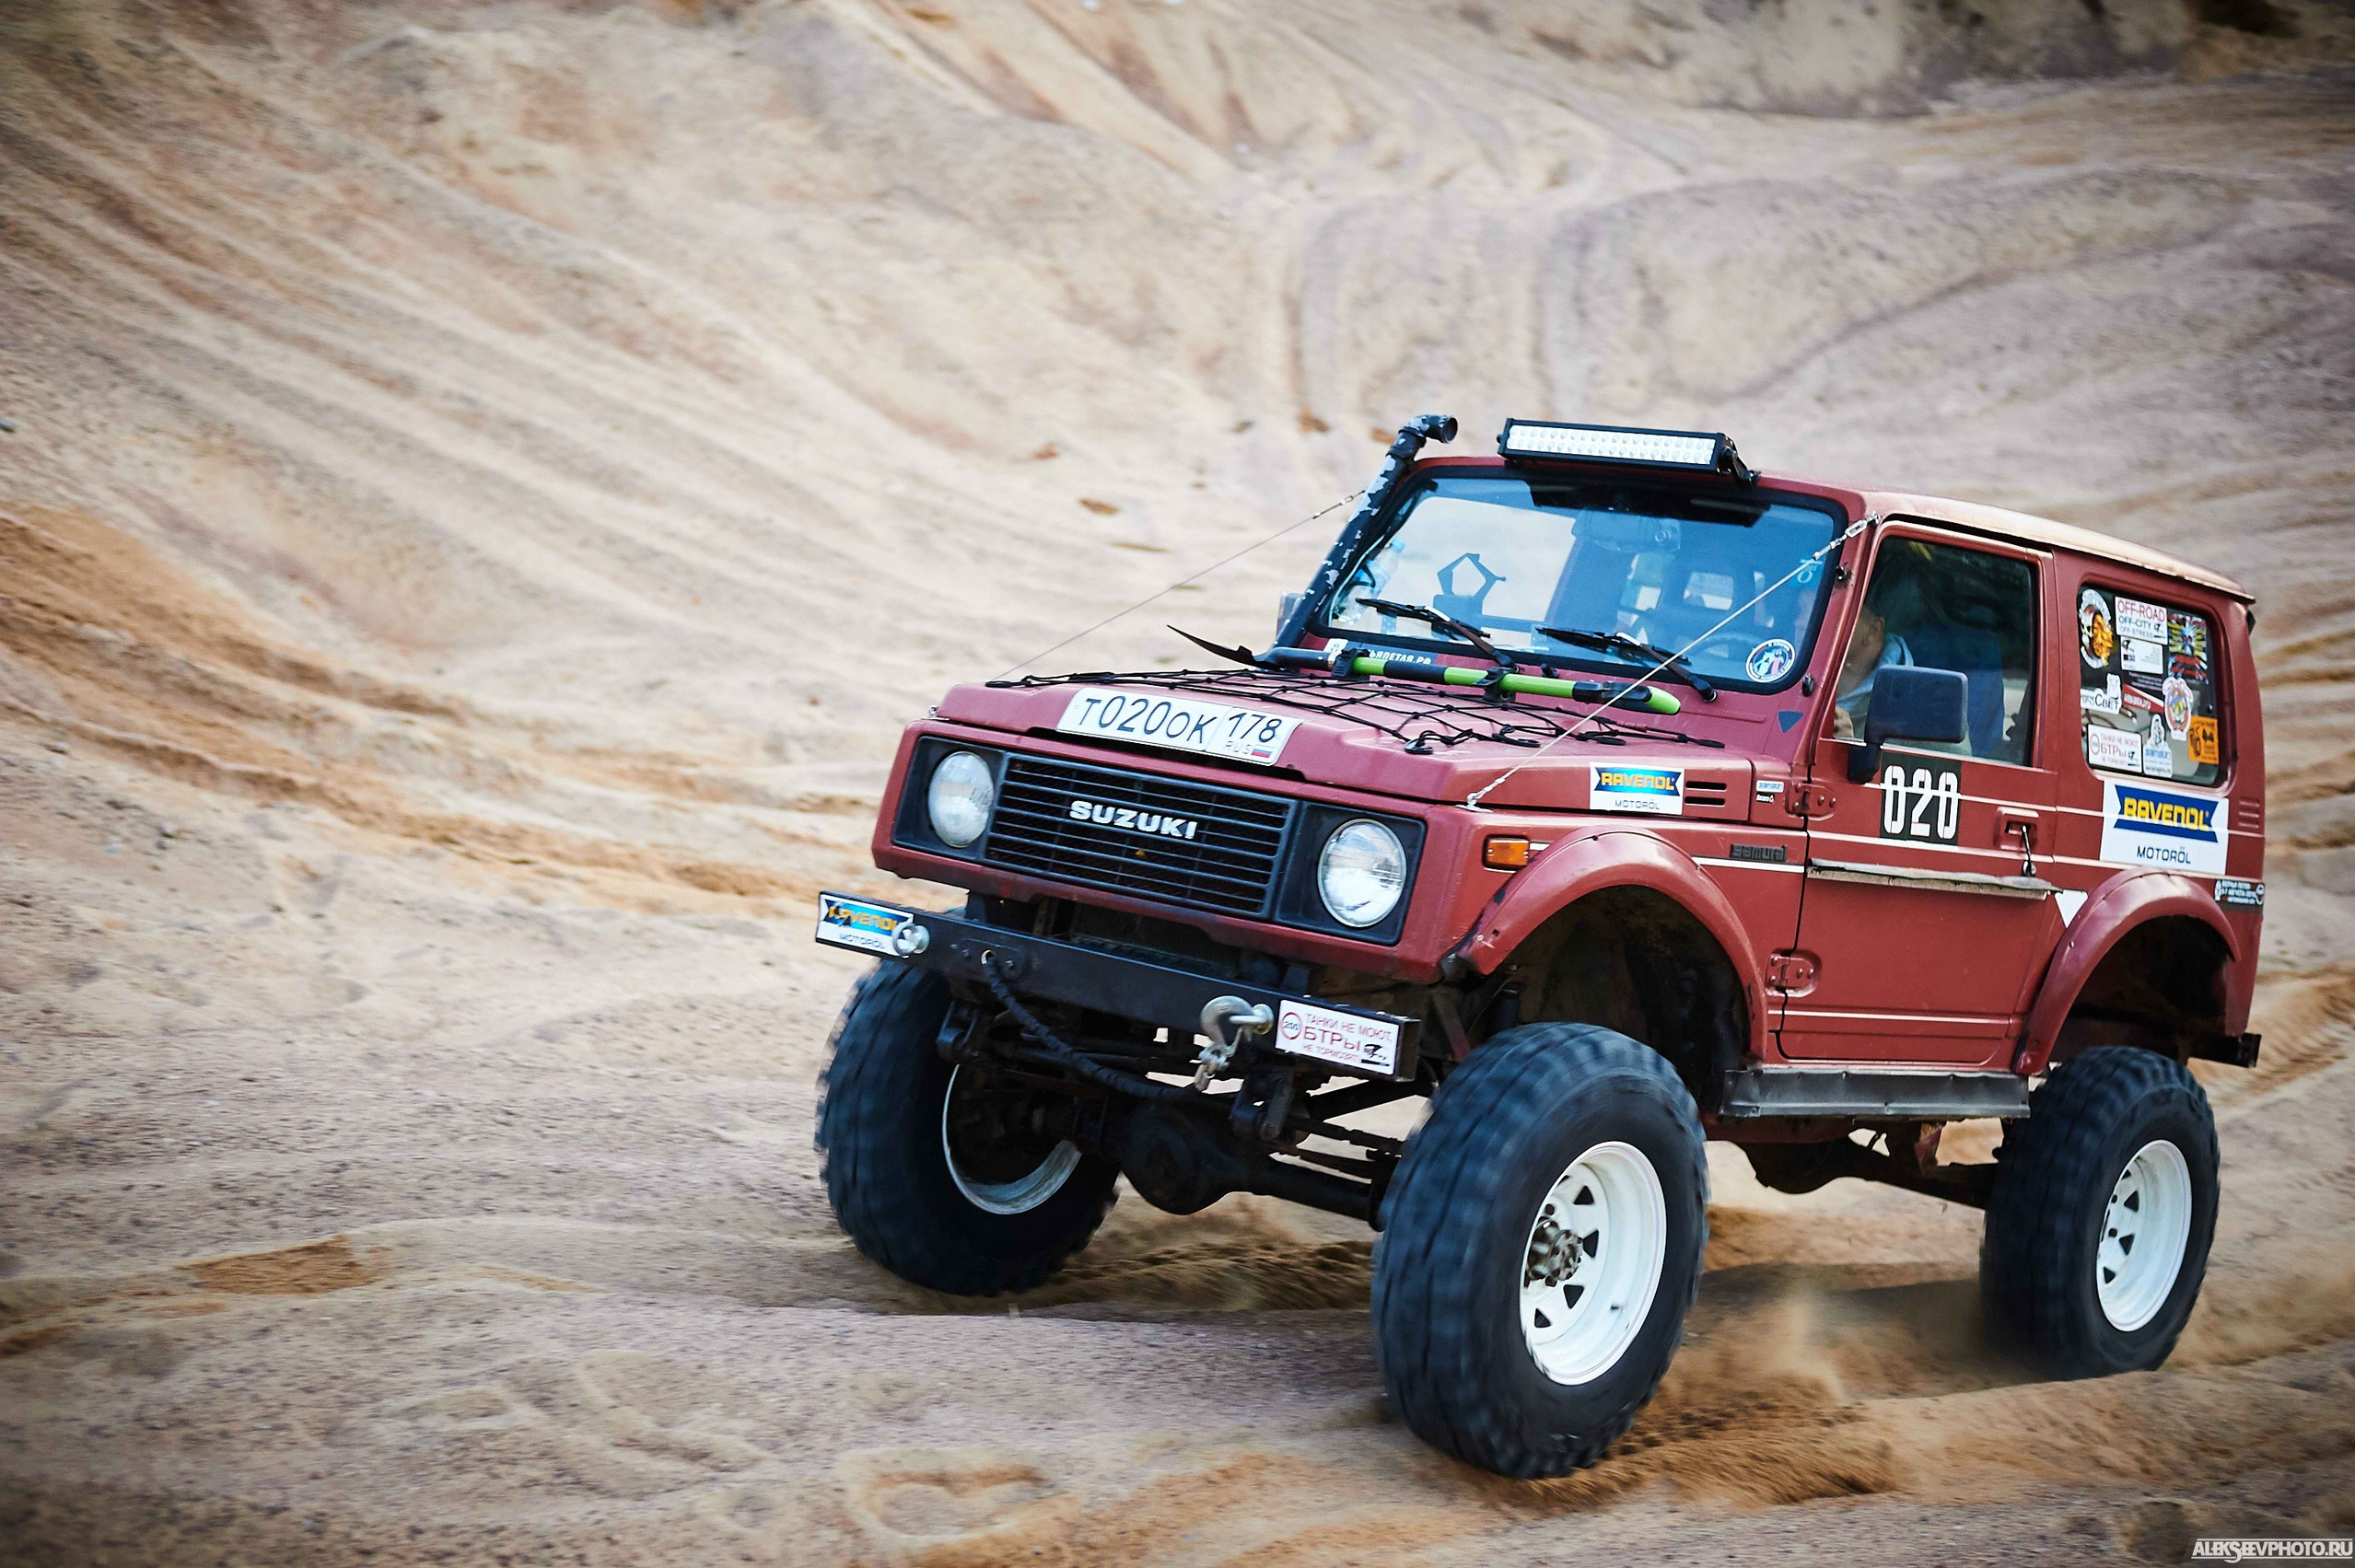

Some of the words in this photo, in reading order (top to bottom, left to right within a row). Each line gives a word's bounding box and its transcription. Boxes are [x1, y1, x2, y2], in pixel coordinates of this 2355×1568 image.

[2117, 600, 2165, 622] OFF-ROAD
[1368, 649, 1431, 664] ЬЯПЕТЛЯ.РФ
[1229, 712, 1283, 743] 178
[1601, 772, 1675, 791] RAVENOL
[1615, 798, 1660, 810] MOTORÖL
[1883, 765, 1958, 840] 020
[1069, 800, 1197, 839] SUZUKI
[2124, 796, 2210, 832] RAVENOL
[2136, 845, 2192, 865] MOTORÖL
